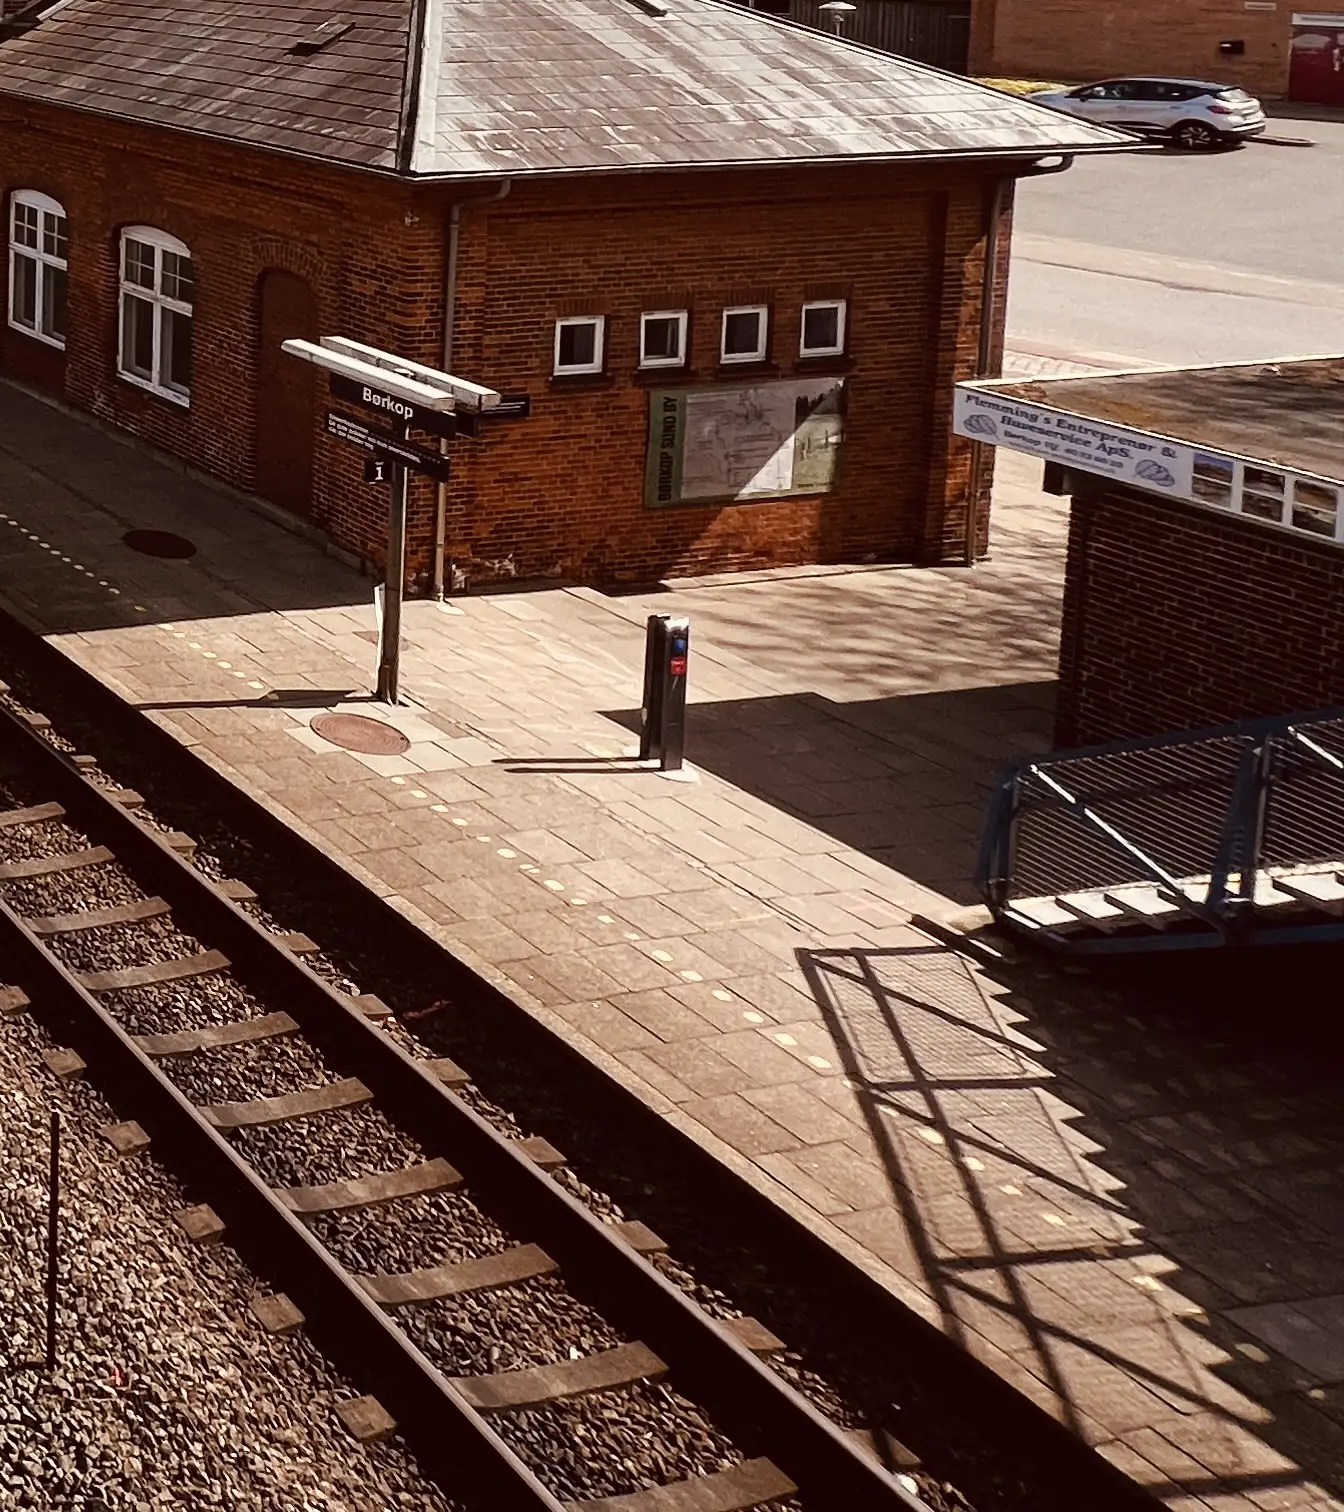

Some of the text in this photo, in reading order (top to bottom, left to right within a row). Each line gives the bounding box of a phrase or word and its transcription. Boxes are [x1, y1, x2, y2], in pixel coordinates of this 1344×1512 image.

[362, 386, 414, 420] Børkop
[663, 396, 679, 413] BY
[661, 415, 677, 449] SUND
[1161, 446, 1178, 459] &
[374, 466, 384, 481] 1
